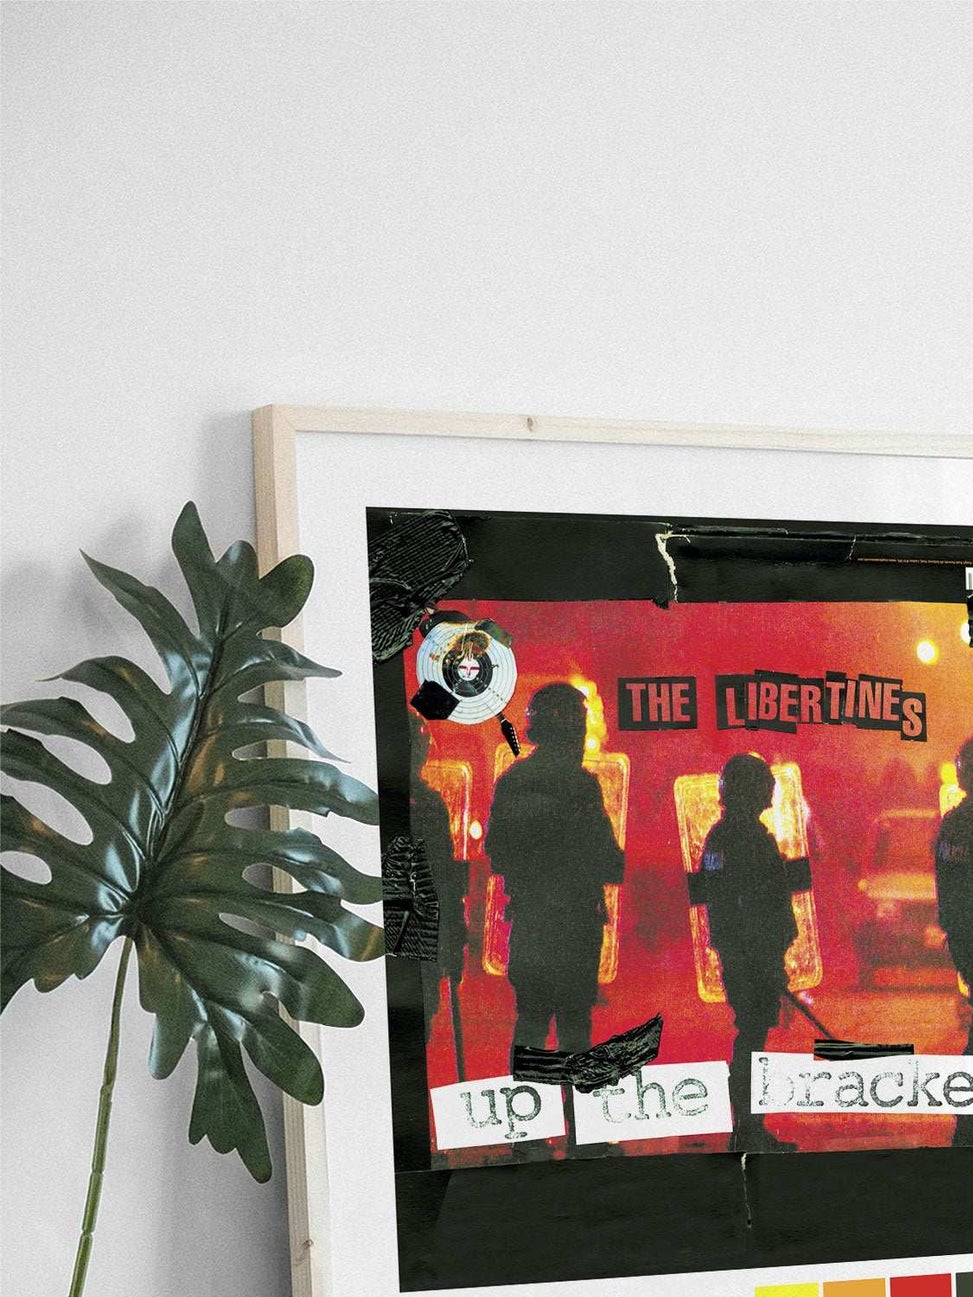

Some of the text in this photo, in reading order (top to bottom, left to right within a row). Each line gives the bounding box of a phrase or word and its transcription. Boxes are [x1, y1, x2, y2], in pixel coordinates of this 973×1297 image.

[626, 680, 923, 738] THE LIBERTINES
[460, 1085, 542, 1139] up
[593, 1067, 709, 1124] the
